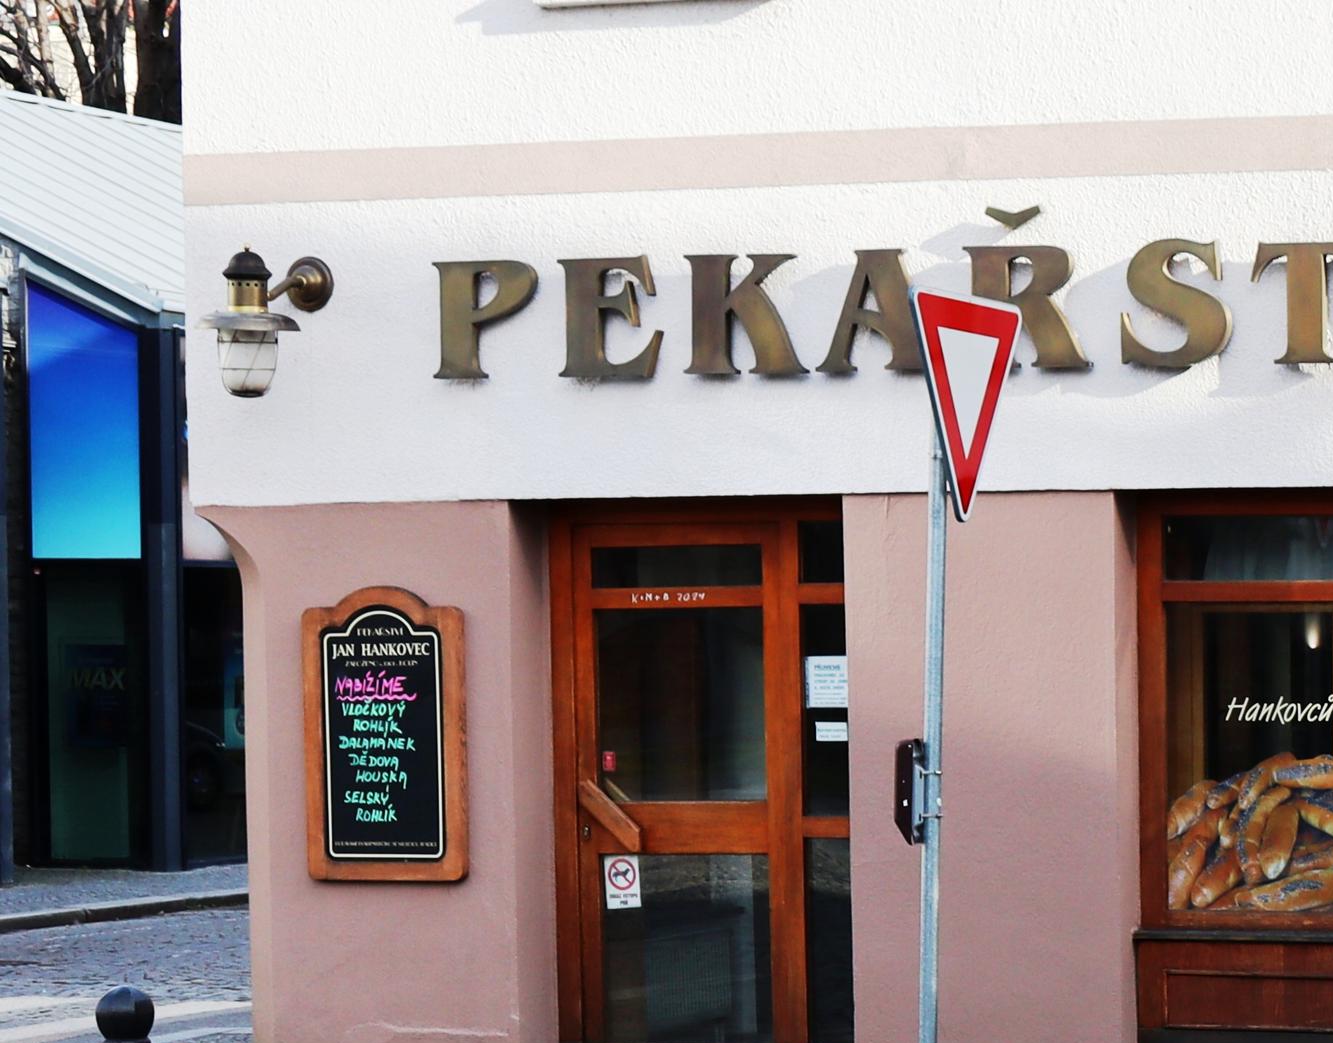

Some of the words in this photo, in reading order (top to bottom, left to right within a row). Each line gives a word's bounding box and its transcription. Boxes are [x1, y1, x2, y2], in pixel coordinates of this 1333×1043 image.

[332, 643, 355, 660] JAN
[361, 642, 430, 657] HANKOVEC
[341, 697, 406, 718] VLOČKOVÝ
[353, 716, 403, 735] ROHLÍK
[356, 769, 407, 789] HOUSKA
[356, 803, 398, 822] ROHLÍK
